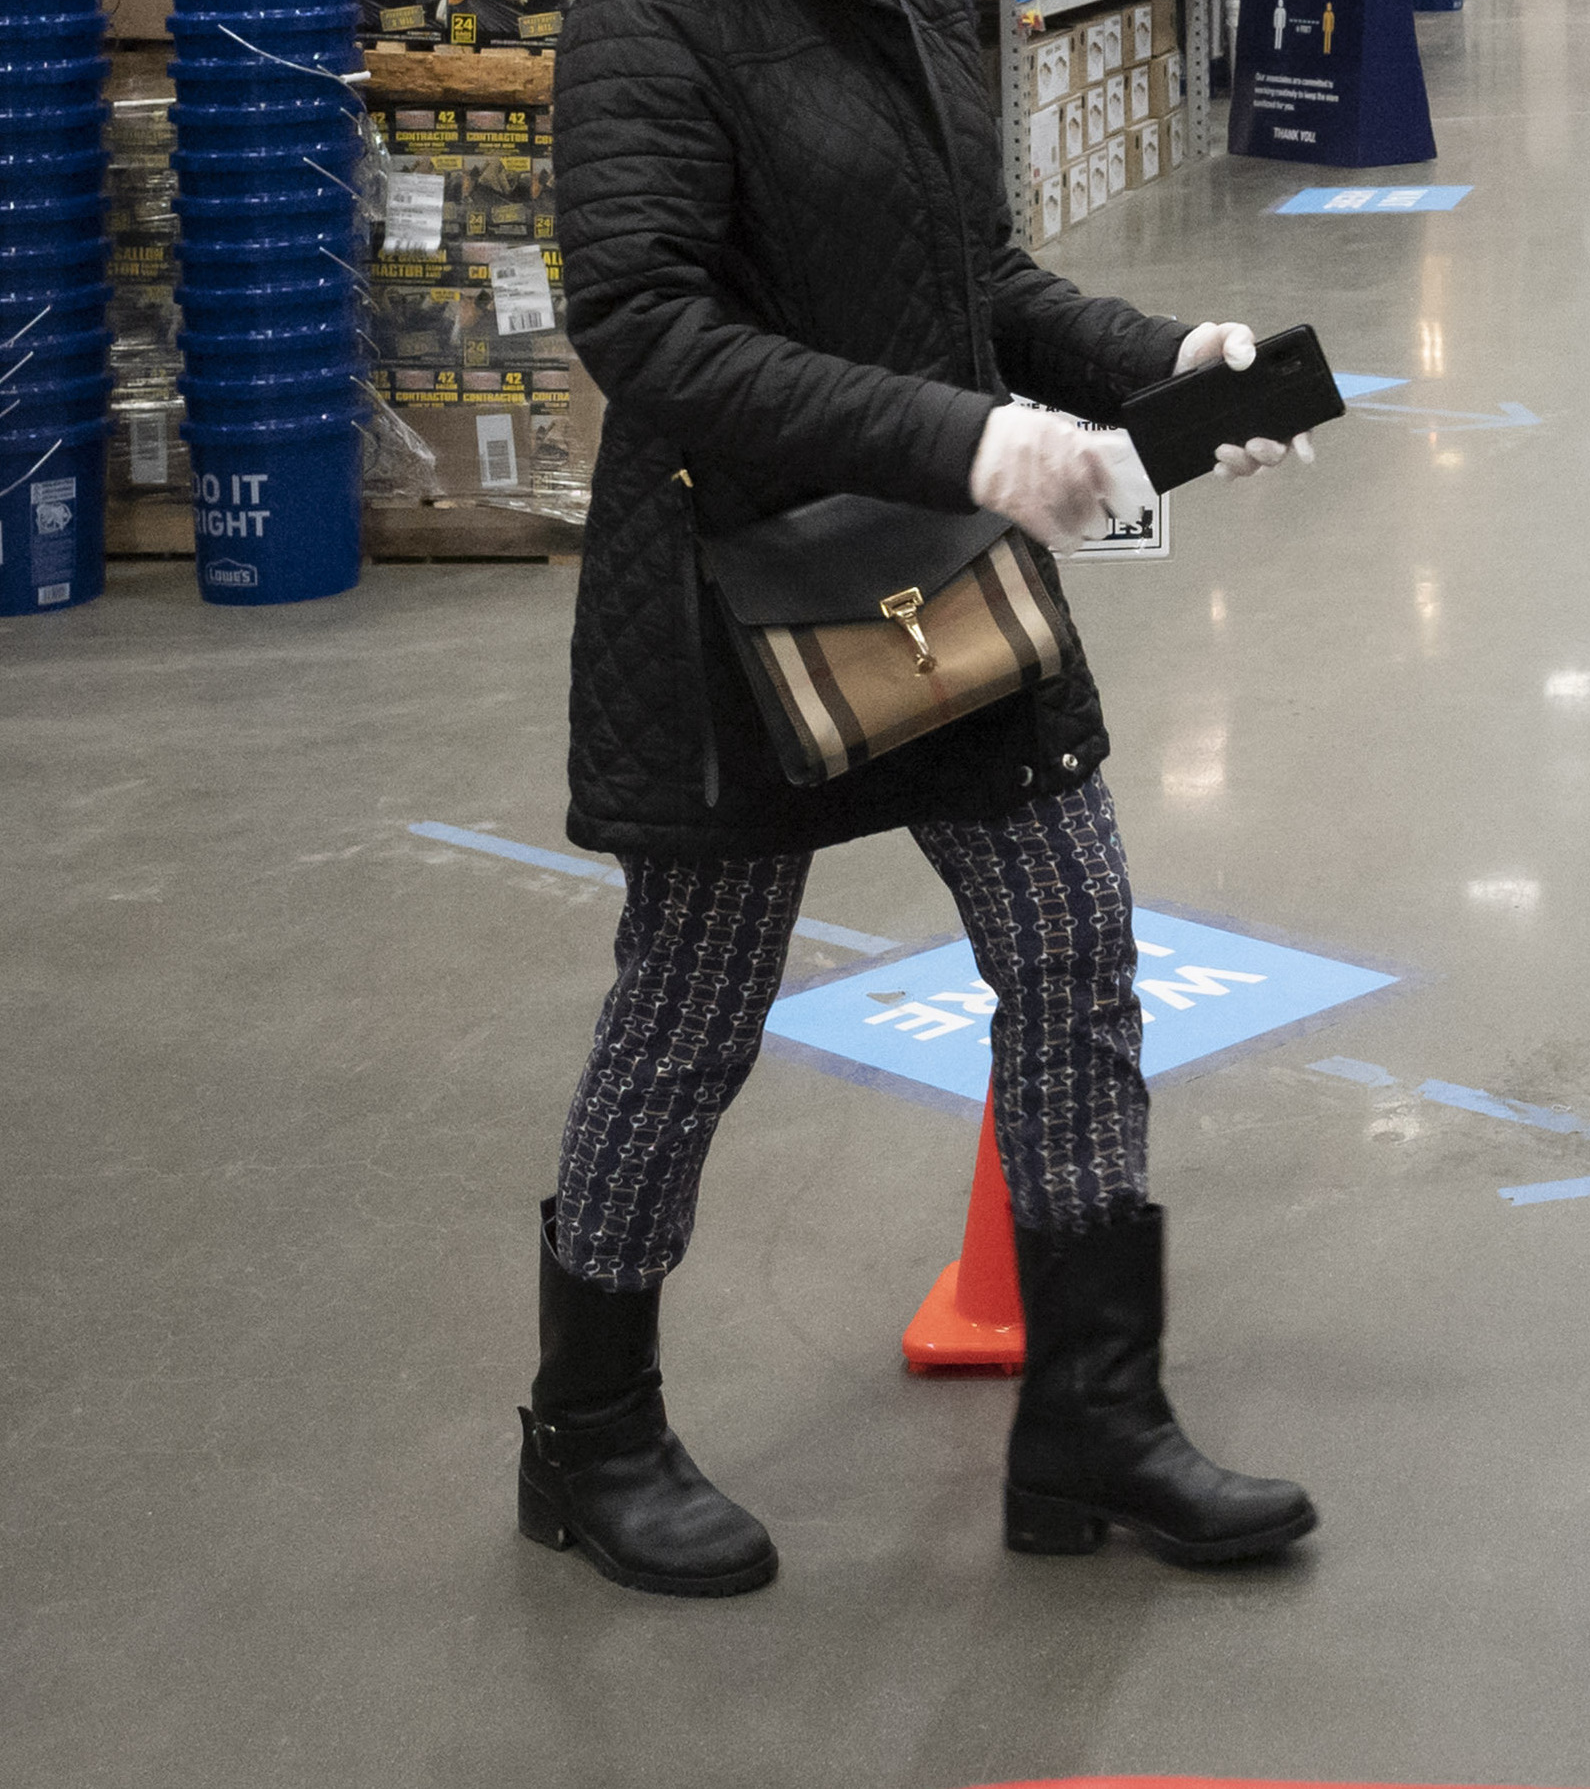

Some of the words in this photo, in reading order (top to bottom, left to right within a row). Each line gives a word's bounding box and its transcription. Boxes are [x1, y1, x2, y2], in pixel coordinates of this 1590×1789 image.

[453, 18, 473, 31] 24
[1273, 127, 1299, 142] THANK
[231, 474, 269, 505] IT
